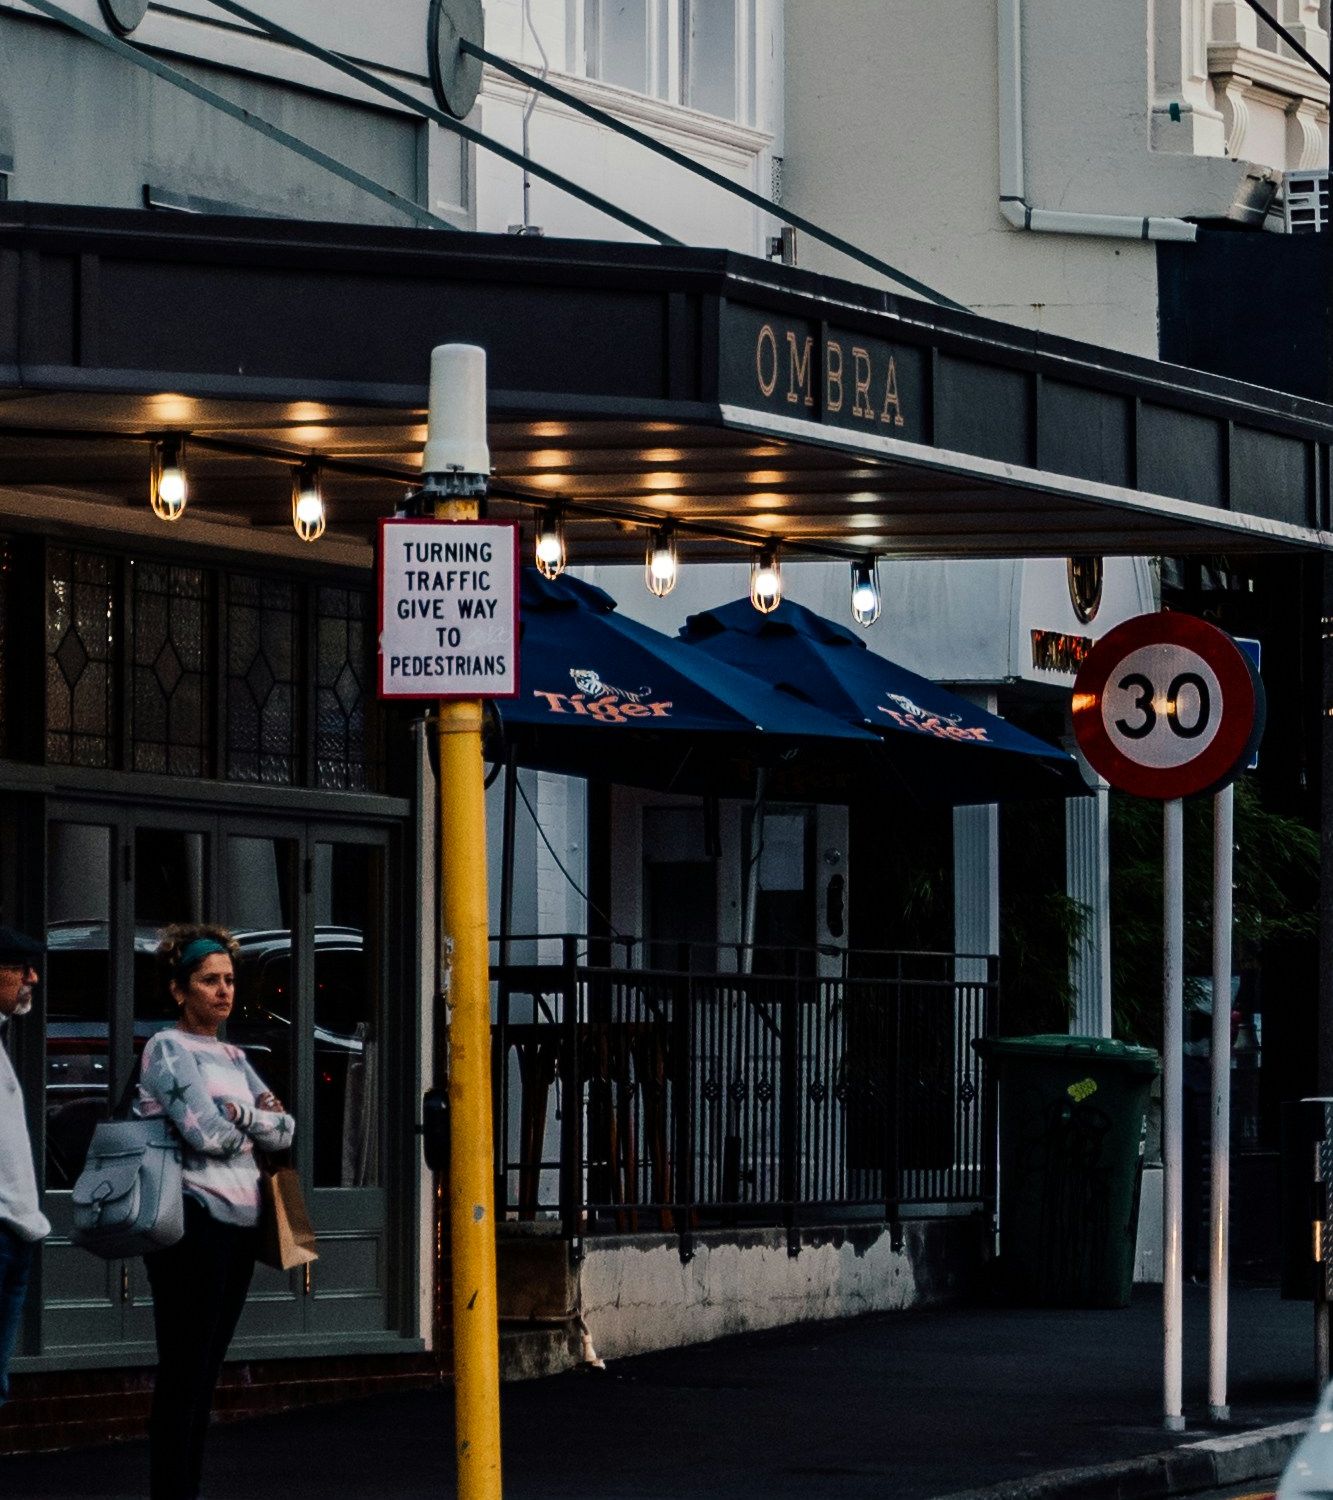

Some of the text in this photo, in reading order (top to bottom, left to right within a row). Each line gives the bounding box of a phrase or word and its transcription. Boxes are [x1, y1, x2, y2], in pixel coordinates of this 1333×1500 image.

[756, 324, 904, 427] OMBRA
[403, 542, 492, 563] TURNING
[405, 571, 491, 591] TRAFFIC
[397, 599, 498, 619] GIVE WAY
[436, 627, 461, 648] TO
[390, 656, 506, 677] PEDESTRIANS
[533, 689, 673, 723] Tiger
[1115, 672, 1211, 740] 30
